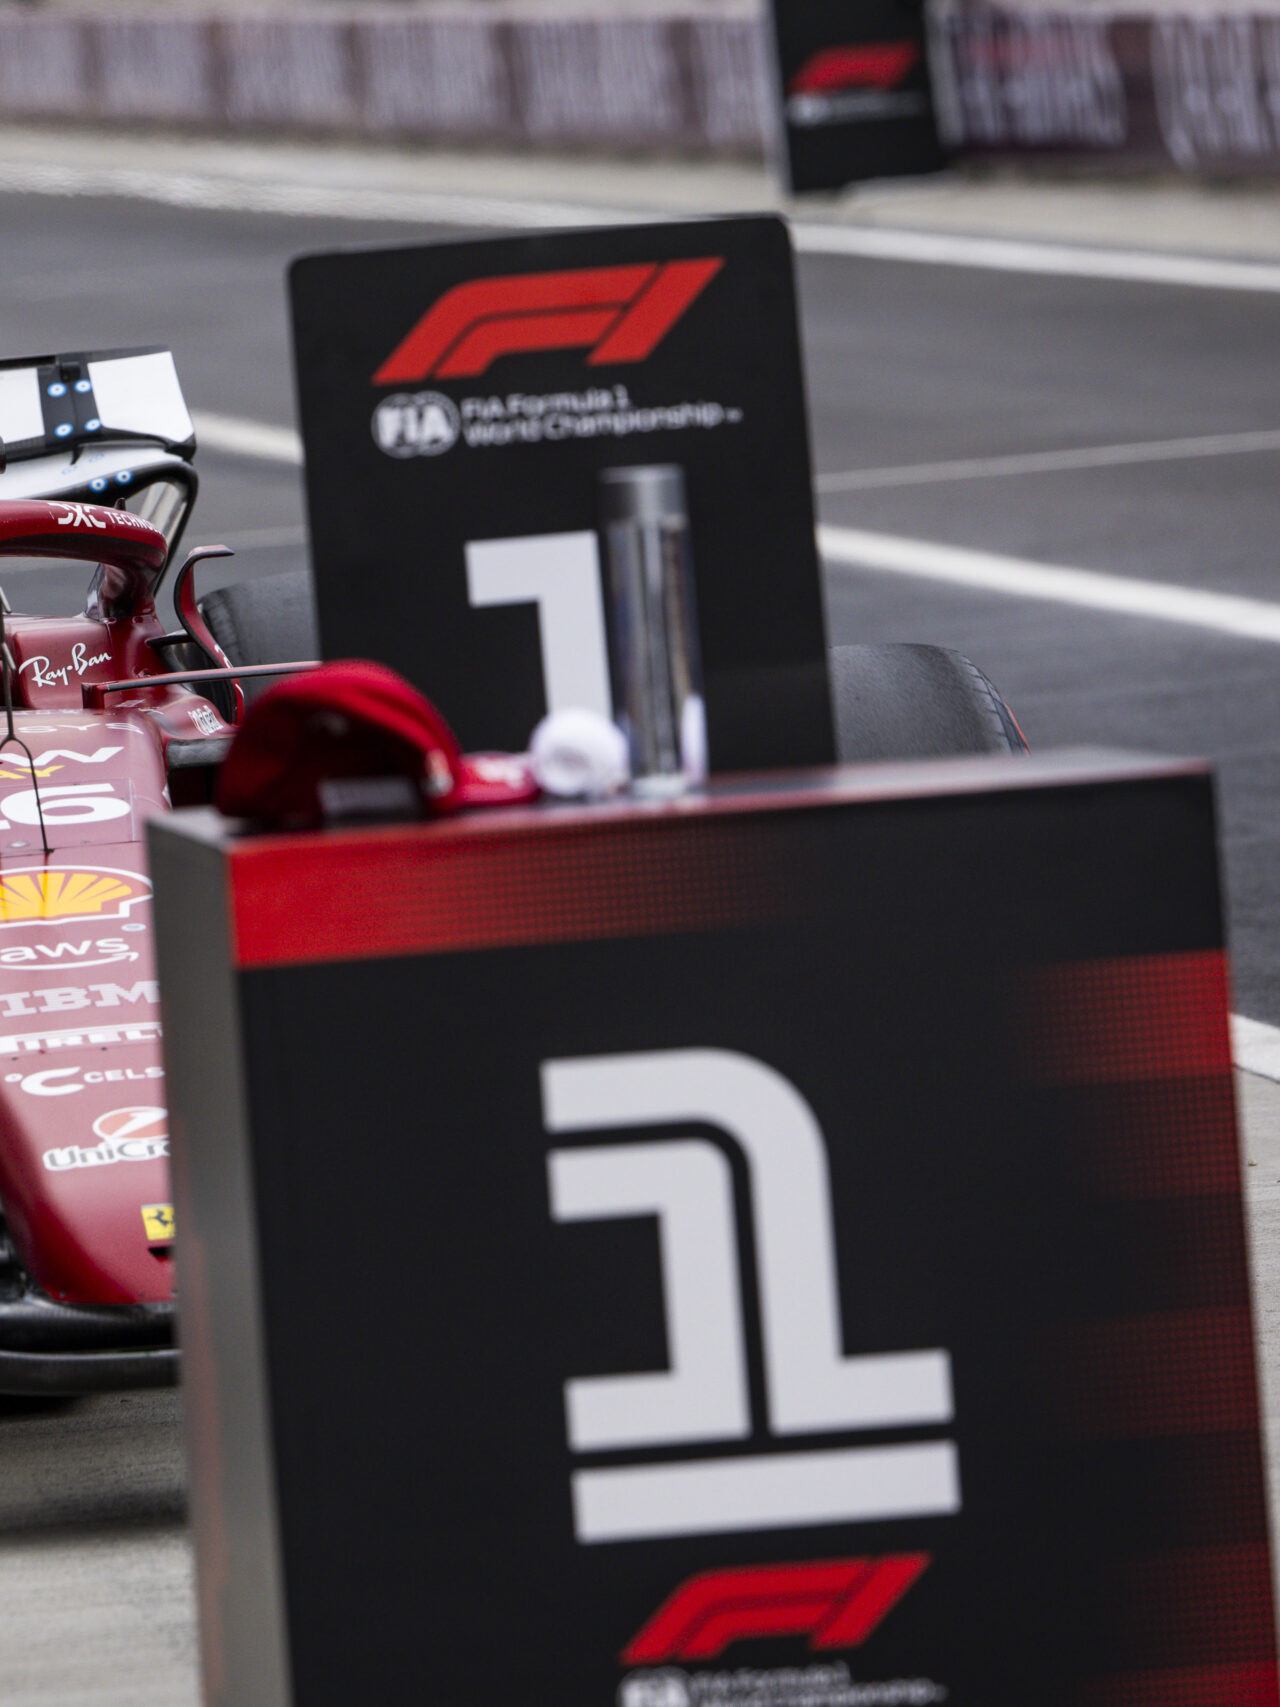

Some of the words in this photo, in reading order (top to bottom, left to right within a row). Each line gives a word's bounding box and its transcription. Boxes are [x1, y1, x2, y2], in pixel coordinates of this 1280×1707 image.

[371, 256, 724, 386] F1
[375, 402, 457, 451] FIA
[19, 642, 112, 688] Ray-Ban
[0, 938, 132, 965] aws
[83, 1066, 165, 1084] CELS
[45, 1138, 170, 1170] UniCr
[540, 1047, 963, 1544] 1
[620, 1553, 931, 1665] F1
